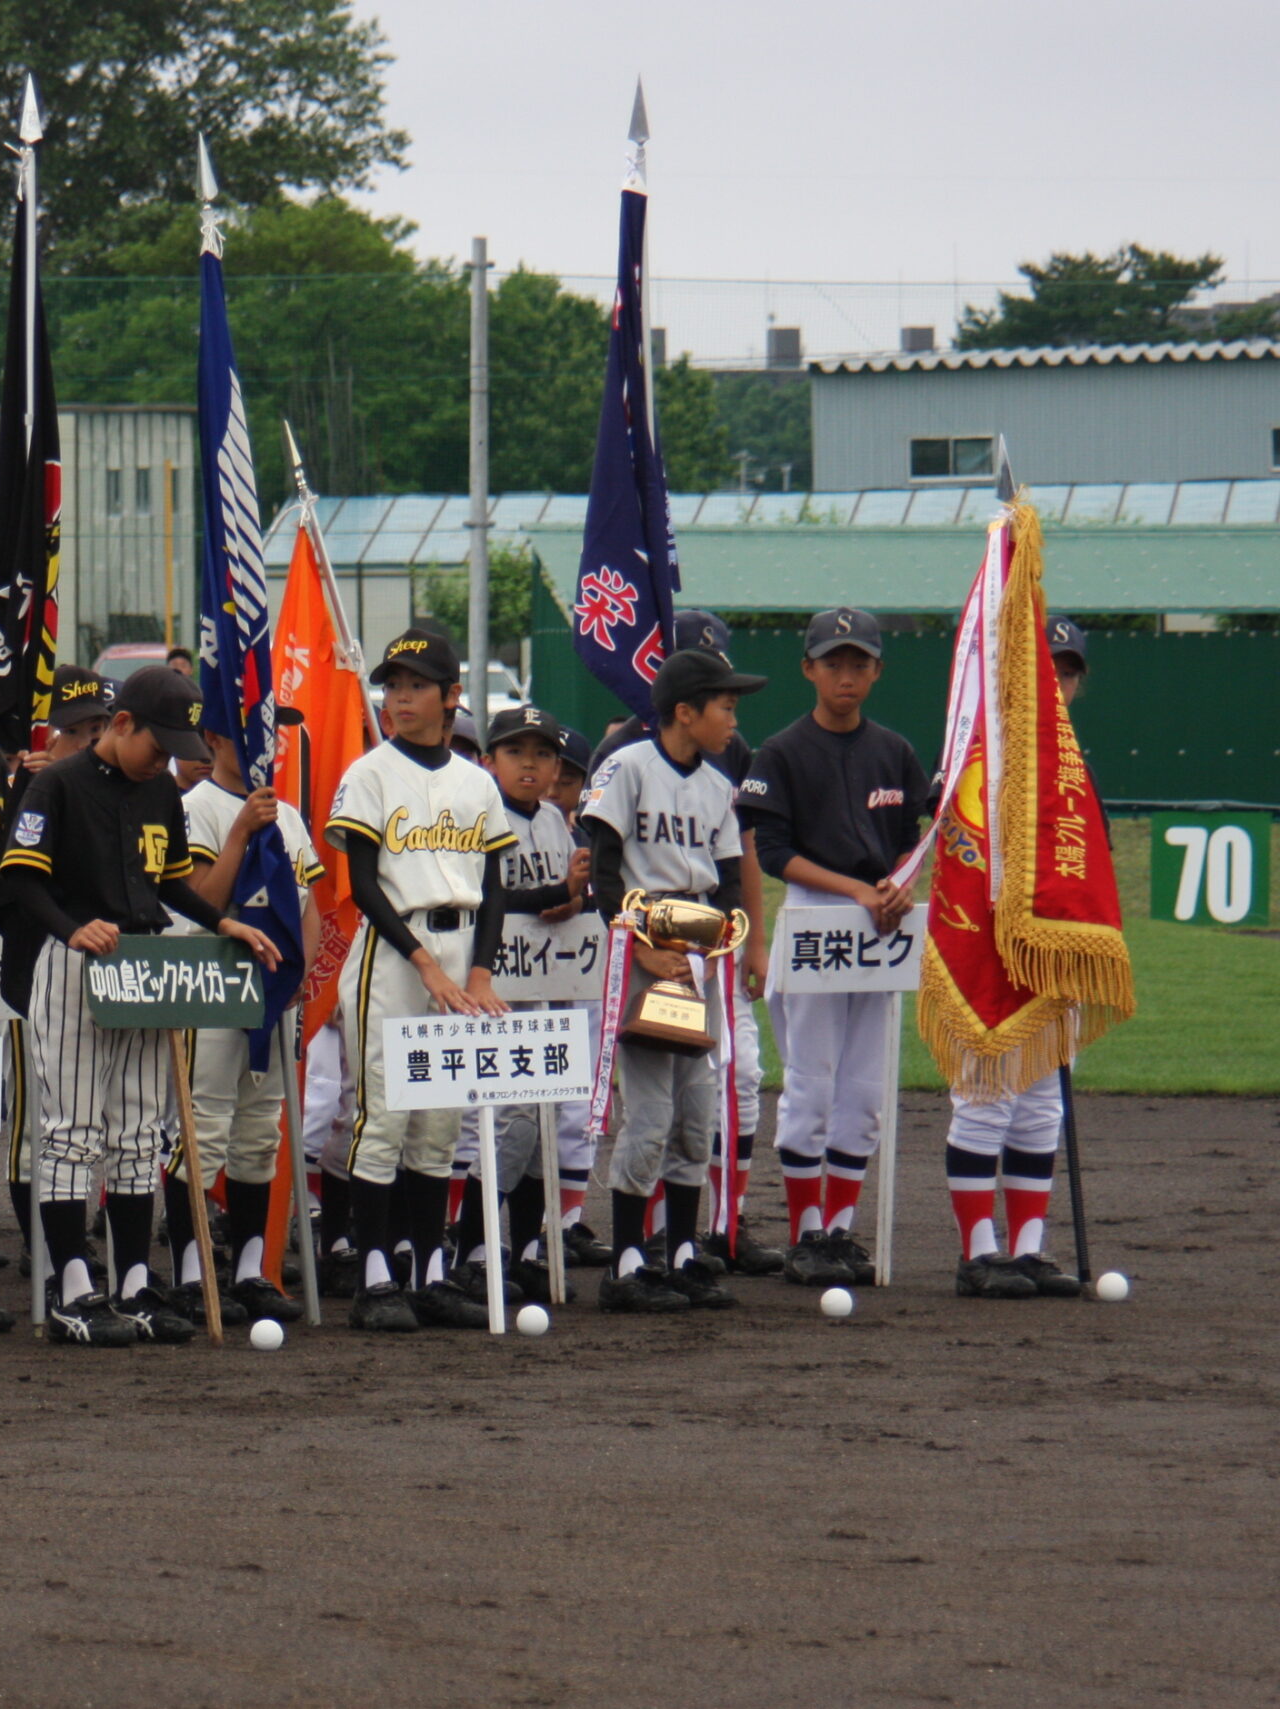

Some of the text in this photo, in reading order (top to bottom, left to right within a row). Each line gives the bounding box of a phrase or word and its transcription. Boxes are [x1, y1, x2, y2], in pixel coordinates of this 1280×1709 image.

[834, 614, 853, 636] S
[1053, 622, 1070, 644] S
[699, 626, 715, 648] S
[62, 680, 99, 701] Sheep
[103, 681, 116, 702] S
[523, 707, 542, 726] E
[1164, 825, 1253, 924] 70
[88, 959, 260, 1004] 中の島ビックタイガース
[400, 1016, 571, 1039] 札幌市少年軟式野球連盟
[406, 1042, 570, 1083] 豊平区支部
